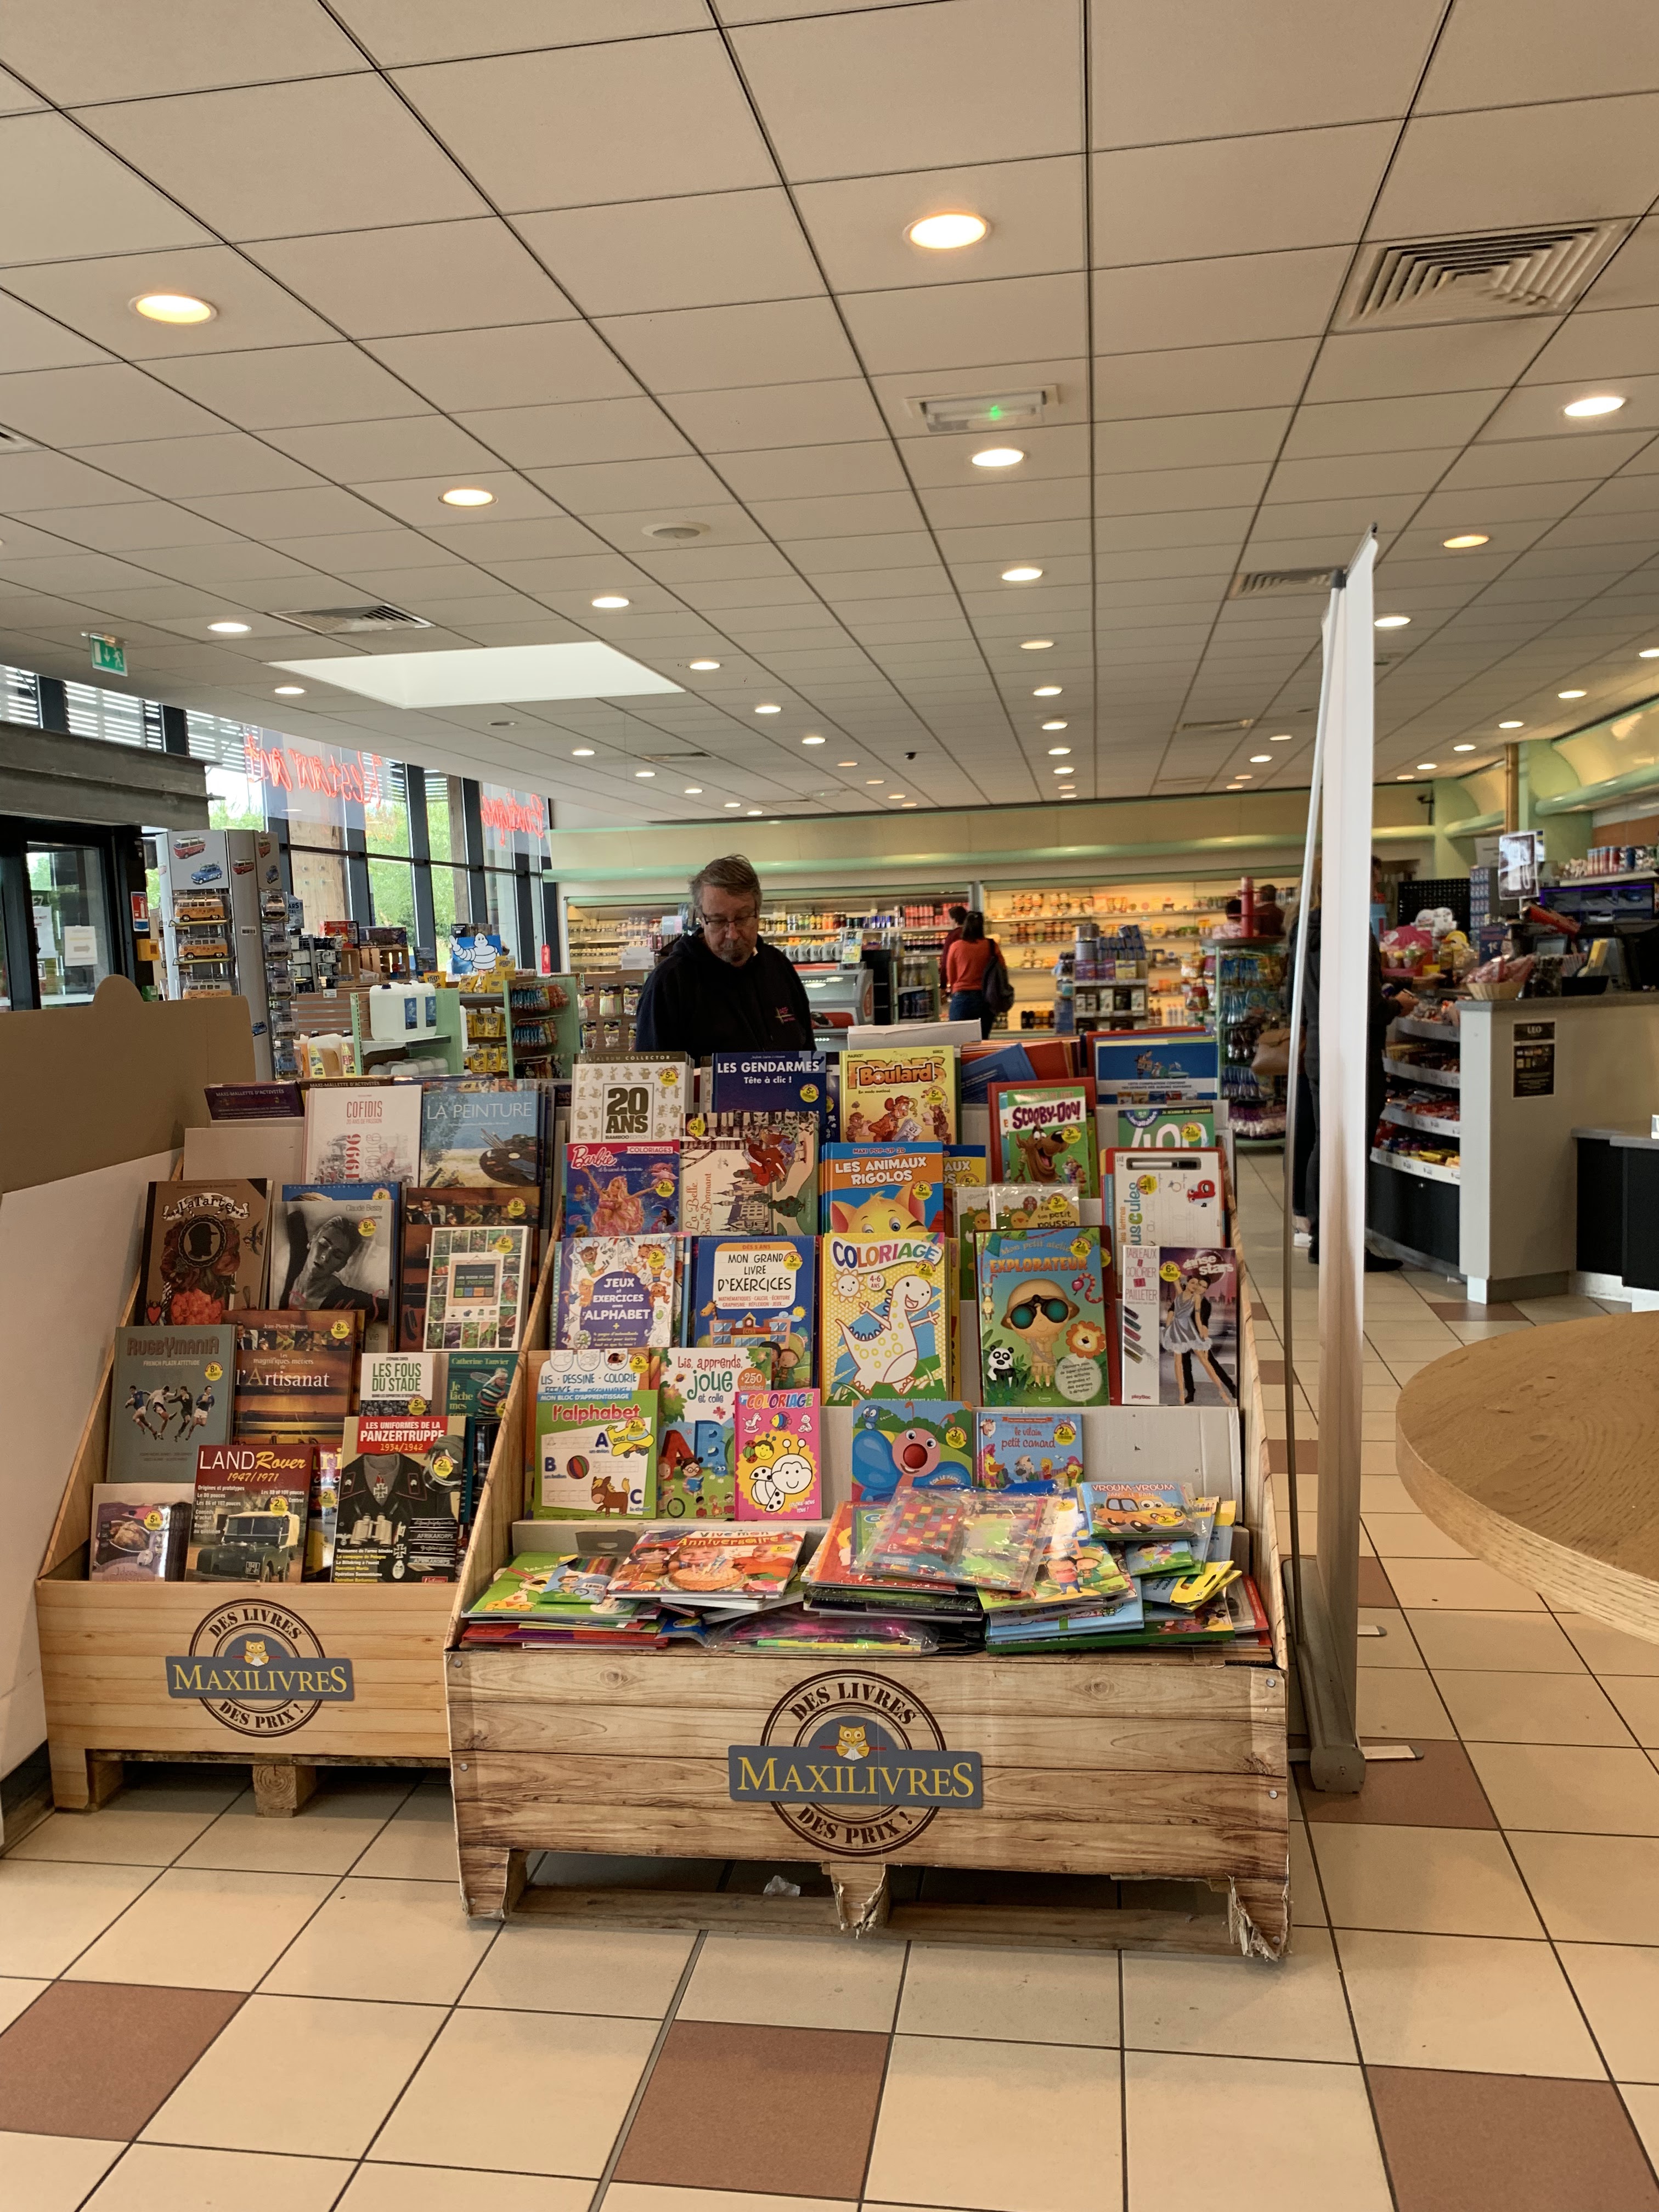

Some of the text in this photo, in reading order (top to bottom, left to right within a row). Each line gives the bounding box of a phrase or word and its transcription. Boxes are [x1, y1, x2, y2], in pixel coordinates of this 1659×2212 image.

[718, 1061, 819, 1073] LES GENDARMES
[859, 1062, 934, 1086] Boulard
[607, 1087, 648, 1116] 20
[347, 1101, 383, 1118] COFIDIS
[427, 1102, 532, 1119] LA PEINTURE
[606, 1115, 648, 1133] ANS
[571, 1146, 617, 1169] Barbie
[835, 1156, 927, 1173] LES ANIMAUX
[851, 1170, 913, 1185] RIGOLOS
[700, 1173, 713, 1215] Dormant
[366, 1204, 383, 1212] Bessy
[686, 1182, 699, 1232] La Belle
[728, 1253, 783, 1263] MON GRAND
[833, 1241, 939, 1269] COLORIAGE
[1126, 1248, 1157, 1259] TABLEAUX
[744, 1265, 766, 1276] LIVRE
[990, 1257, 1088, 1273] EXPLORATEUR
[1126, 1267, 1156, 1278] COLORIER
[1199, 1263, 1234, 1276] stars
[603, 1278, 635, 1288] JEUX
[718, 1277, 792, 1292] D'EXERCICES
[593, 1294, 644, 1302] EXERCICES
[1125, 1289, 1158, 1300] PAILLETER
[678, 1356, 693, 1369] Lis,
[373, 1363, 421, 1378] LES FOUS
[372, 1378, 421, 1392] DU STADE
[452, 1381, 460, 1391] Je
[541, 1372, 637, 1385] LIS DESSINE COLORIE
[687, 1369, 733, 1400] joue
[450, 1392, 473, 1400] lâche
[698, 1394, 724, 1403] et colle
[746, 1393, 814, 1410] COLORIAGE
[552, 1403, 641, 1425] l'alphabet
[1014, 1426, 1042, 1436] le vilain
[380, 1443, 424, 1452] 1934/1942
[595, 1432, 609, 1448] A
[1001, 1437, 1056, 1451] petit canard
[199, 1451, 255, 1470] LAND
[255, 1451, 307, 1470] Rover
[544, 1457, 556, 1472] B
[227, 1472, 280, 1482] 1947/1971
[1092, 1483, 1176, 1492] VROUM-VROUM
[630, 1489, 642, 1504] C
[676, 1536, 779, 1547] Anniversaire
[208, 1608, 302, 1639] DES LIVRES
[172, 1664, 347, 1693] MAXILIVRES
[789, 1682, 918, 1725] DES LIVRES
[219, 1701, 250, 1726] DES
[256, 1711, 296, 1729] PRIX
[737, 1757, 975, 1798] MAXILIVRES
[797, 1805, 839, 1840] DES
[845, 1819, 902, 1845] PRIX
